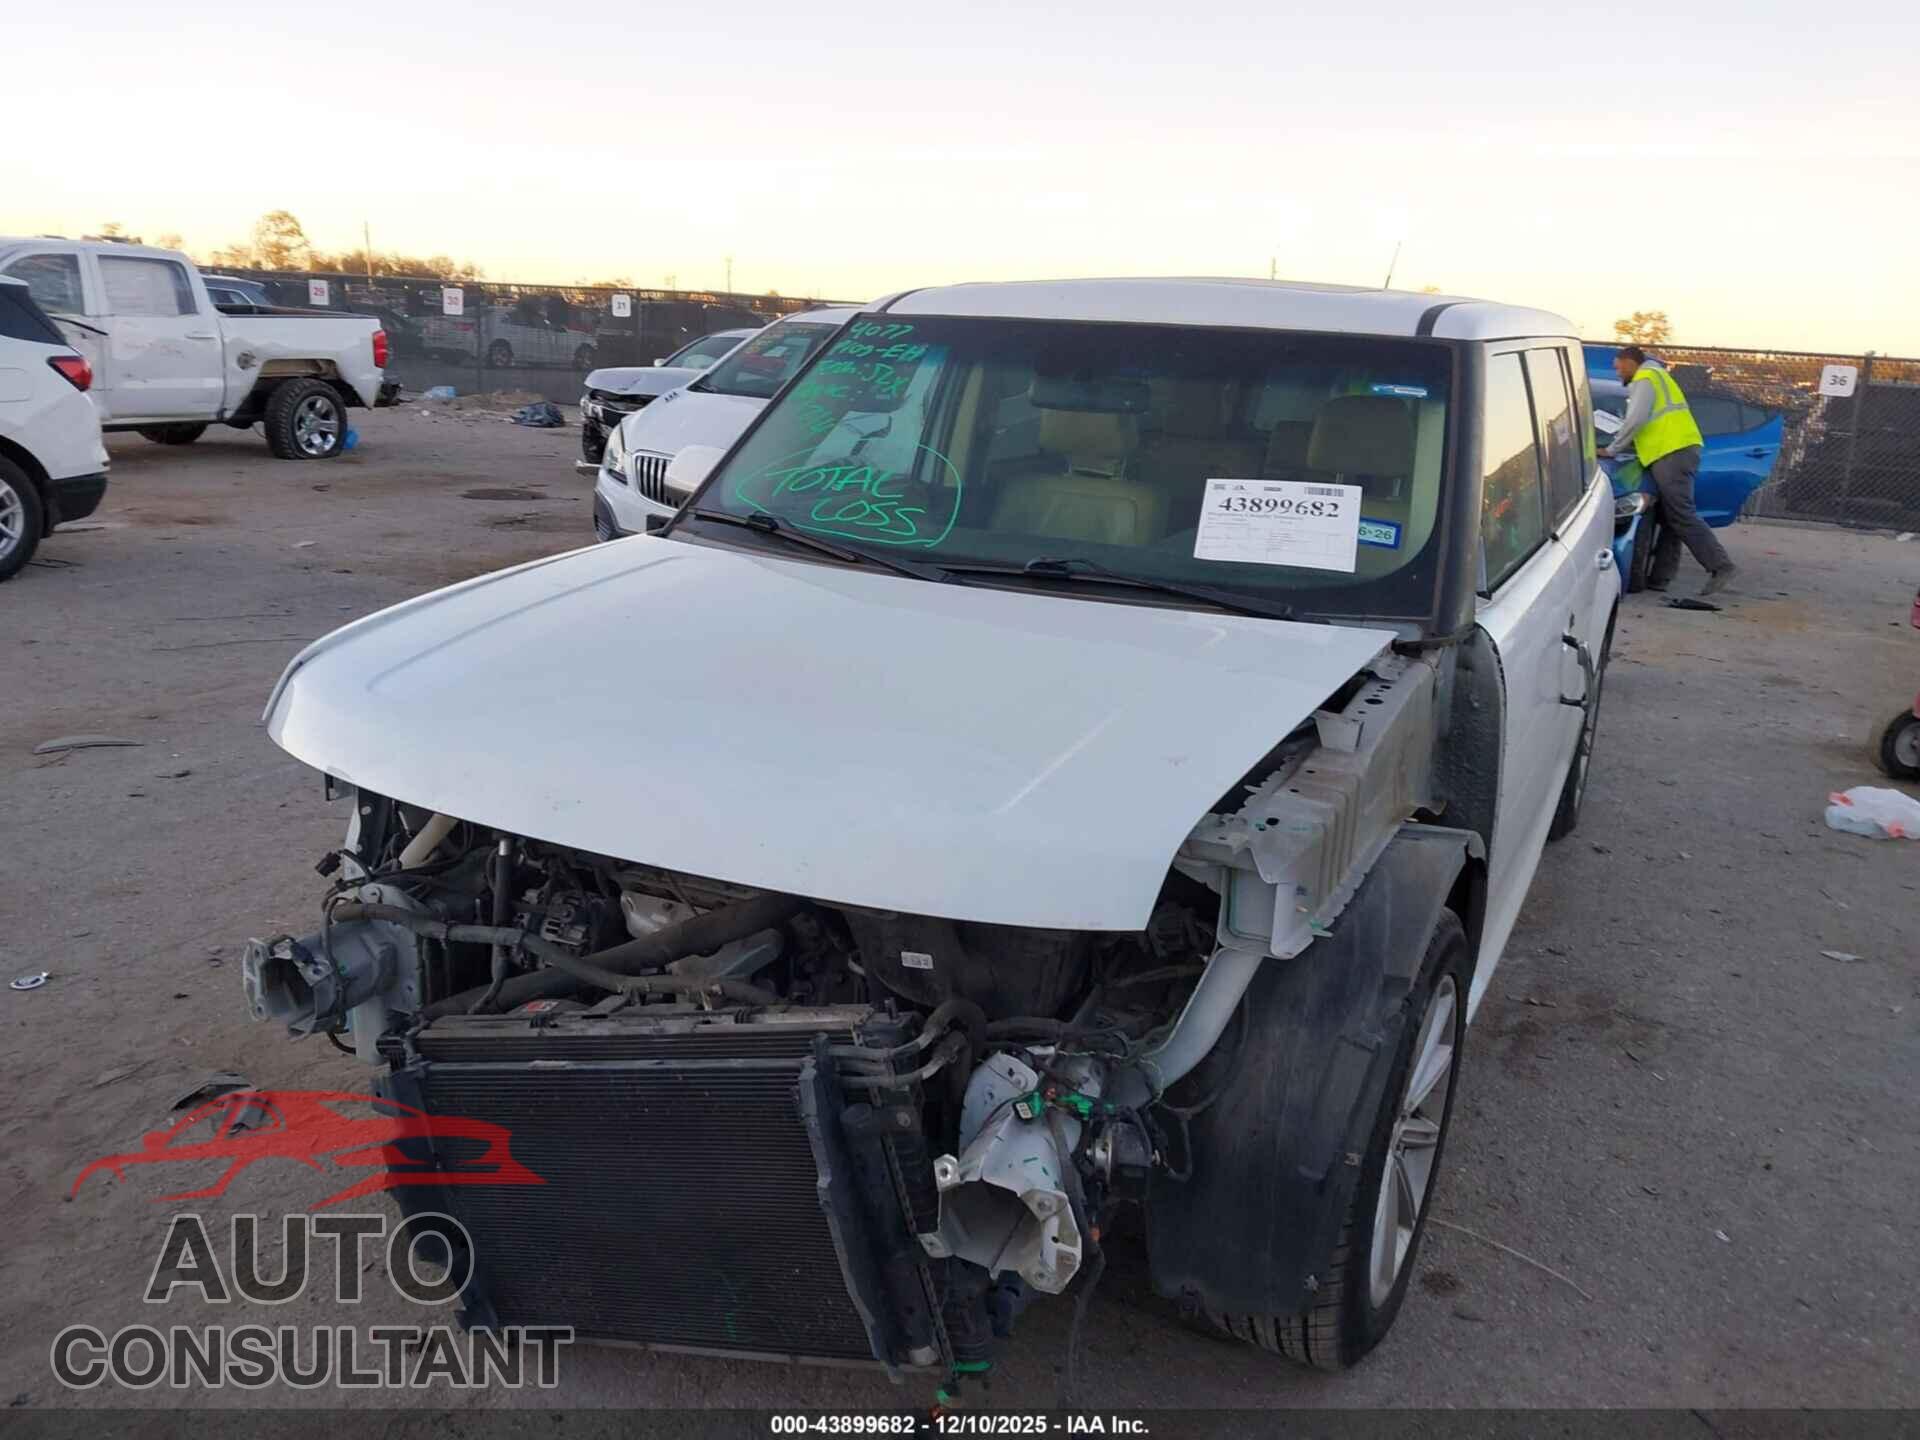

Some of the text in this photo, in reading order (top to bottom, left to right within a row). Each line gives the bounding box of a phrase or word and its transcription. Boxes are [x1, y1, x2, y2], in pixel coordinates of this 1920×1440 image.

[1829, 374, 1849, 386] 36
[765, 466, 904, 498] TOTAL
[811, 499, 926, 536] LOSS
[1218, 496, 1340, 519] 43899682
